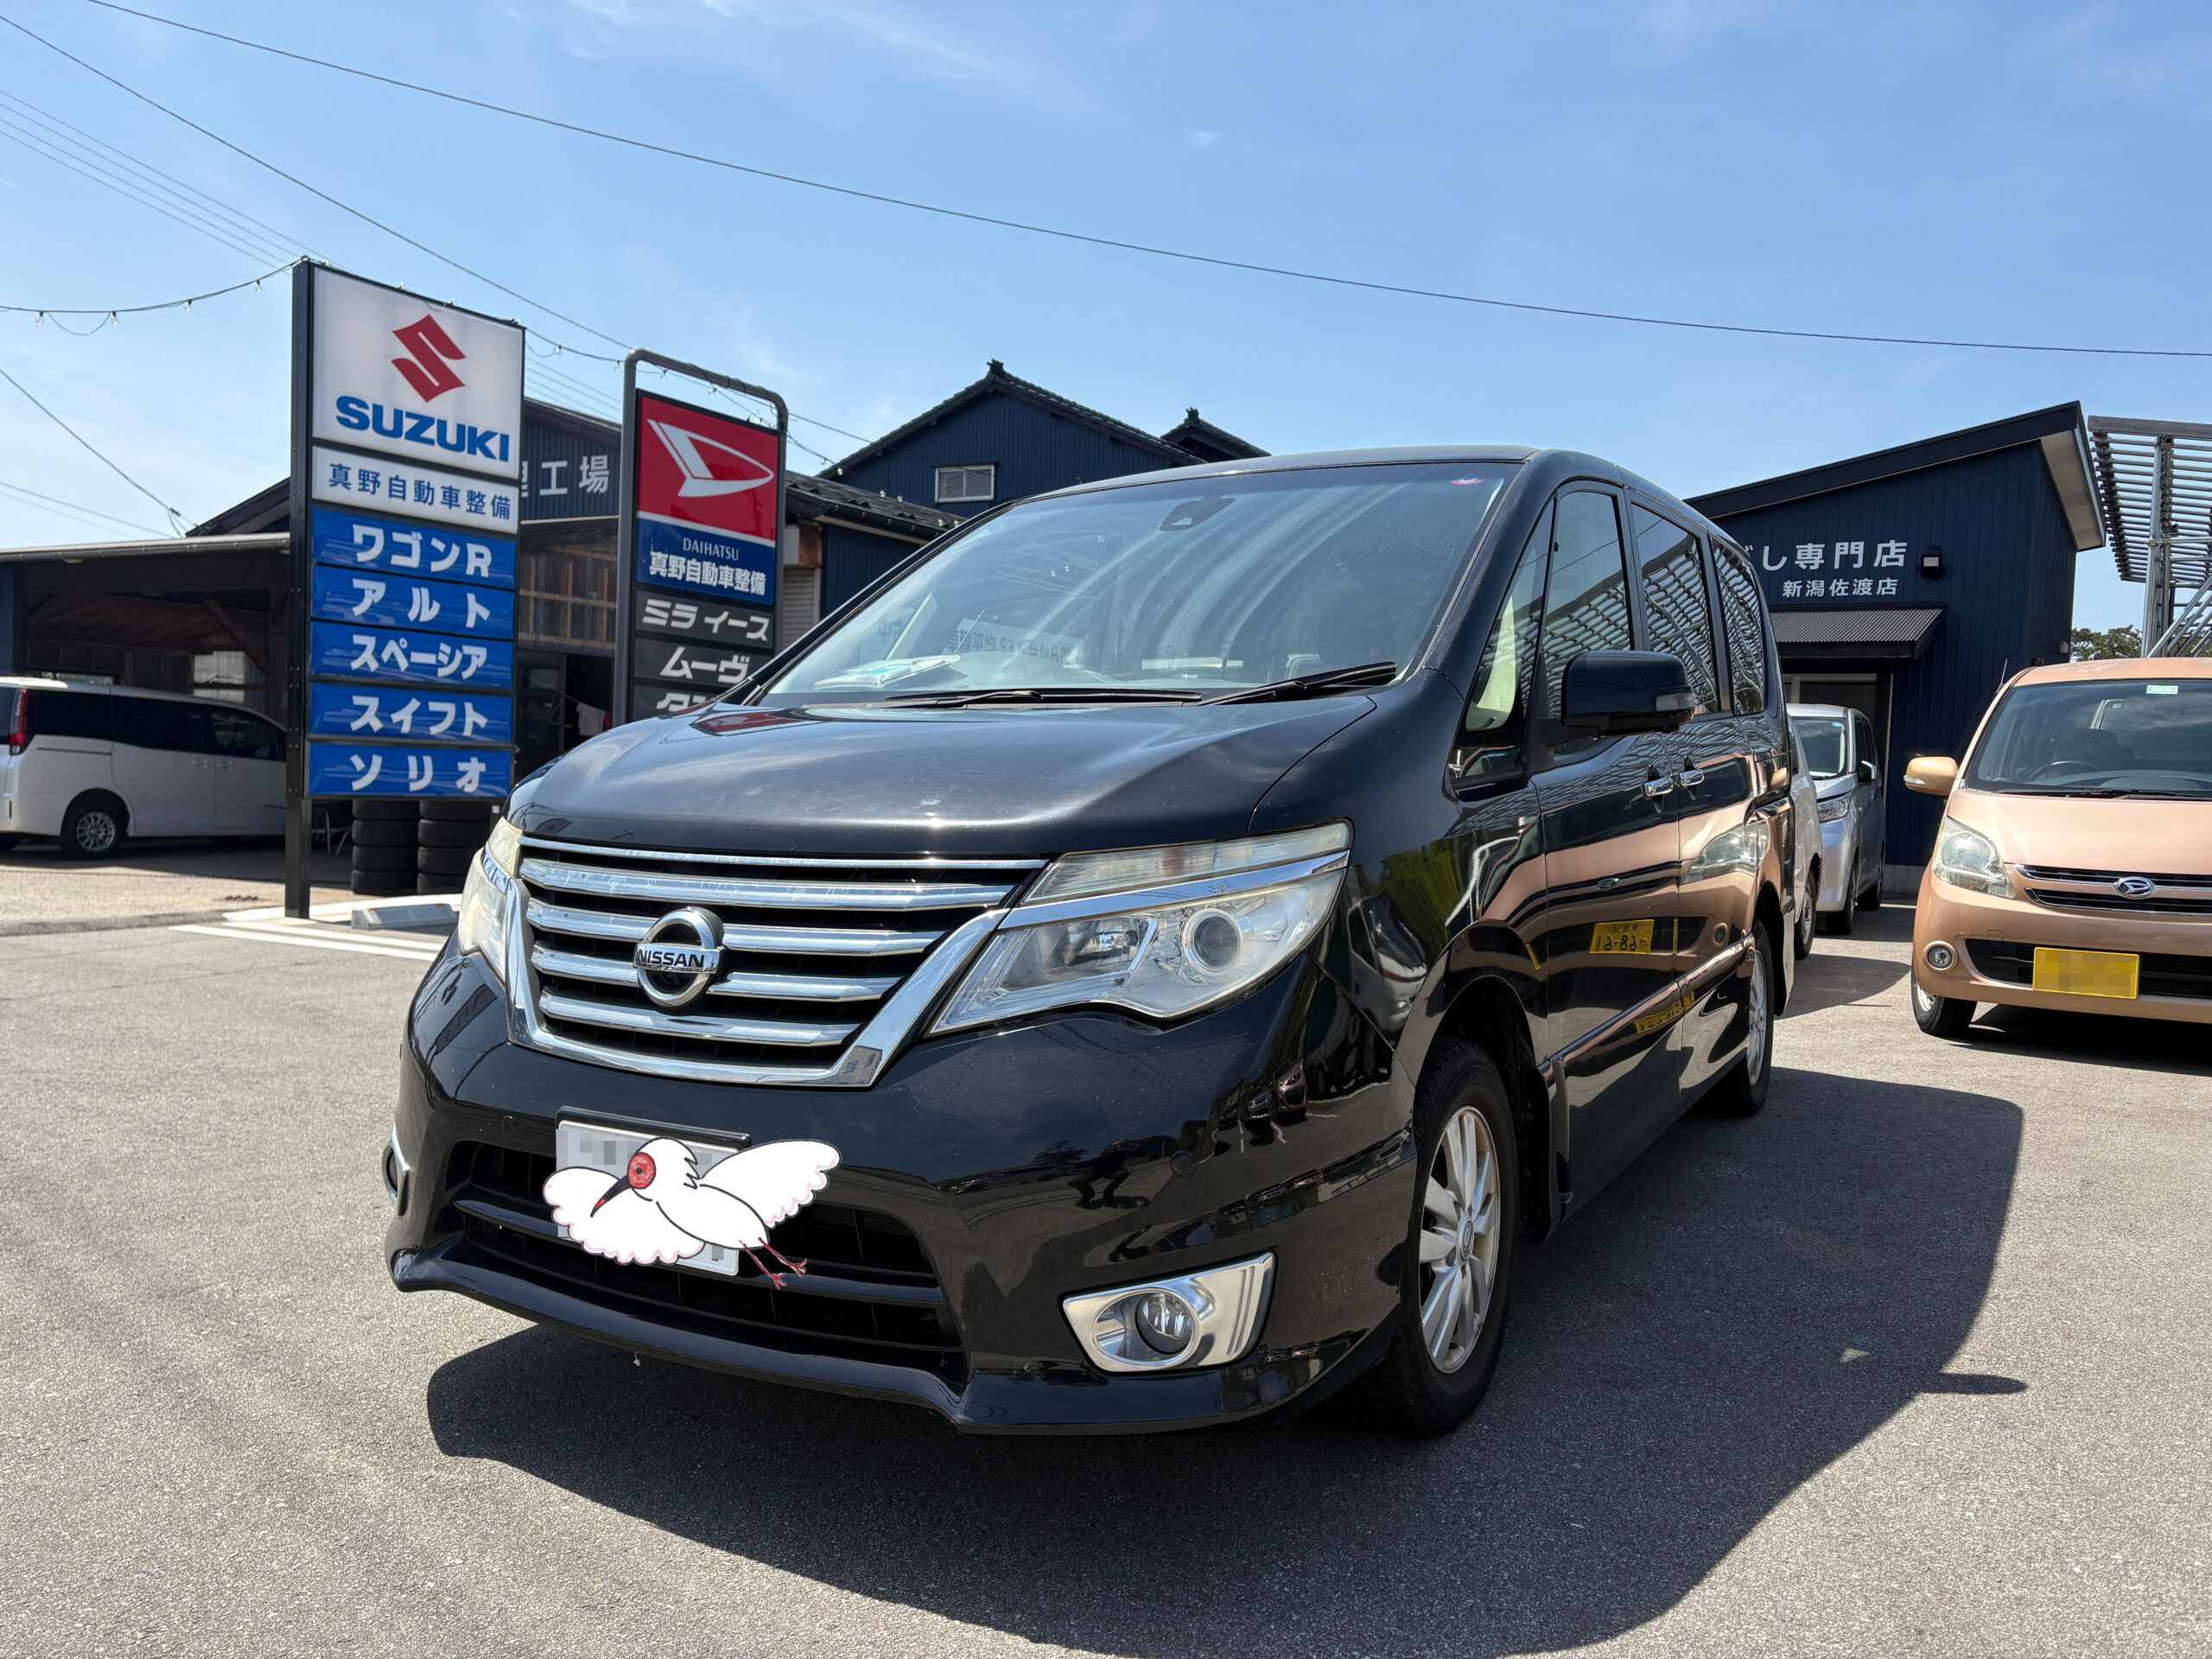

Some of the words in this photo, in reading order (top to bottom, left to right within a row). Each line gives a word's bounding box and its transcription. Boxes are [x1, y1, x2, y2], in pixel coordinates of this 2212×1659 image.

[335, 395, 510, 462] SUZUKI
[329, 463, 511, 520] 真野自動車整備
[353, 524, 493, 578] ワゴンR
[683, 537, 740, 561] DAIHATSU
[1744, 539, 1908, 571] し専門店
[649, 551, 766, 596] 真野自動車整備
[1782, 577, 1898, 598] 新潟佐渡店
[352, 578, 491, 629] アルト
[350, 633, 487, 681] スペーシア
[659, 646, 751, 685] ムーヴ
[349, 695, 488, 737] スイフト
[656, 692, 707, 713] タ
[349, 753, 486, 793] ソリオ
[637, 949, 705, 968] NISSAN
